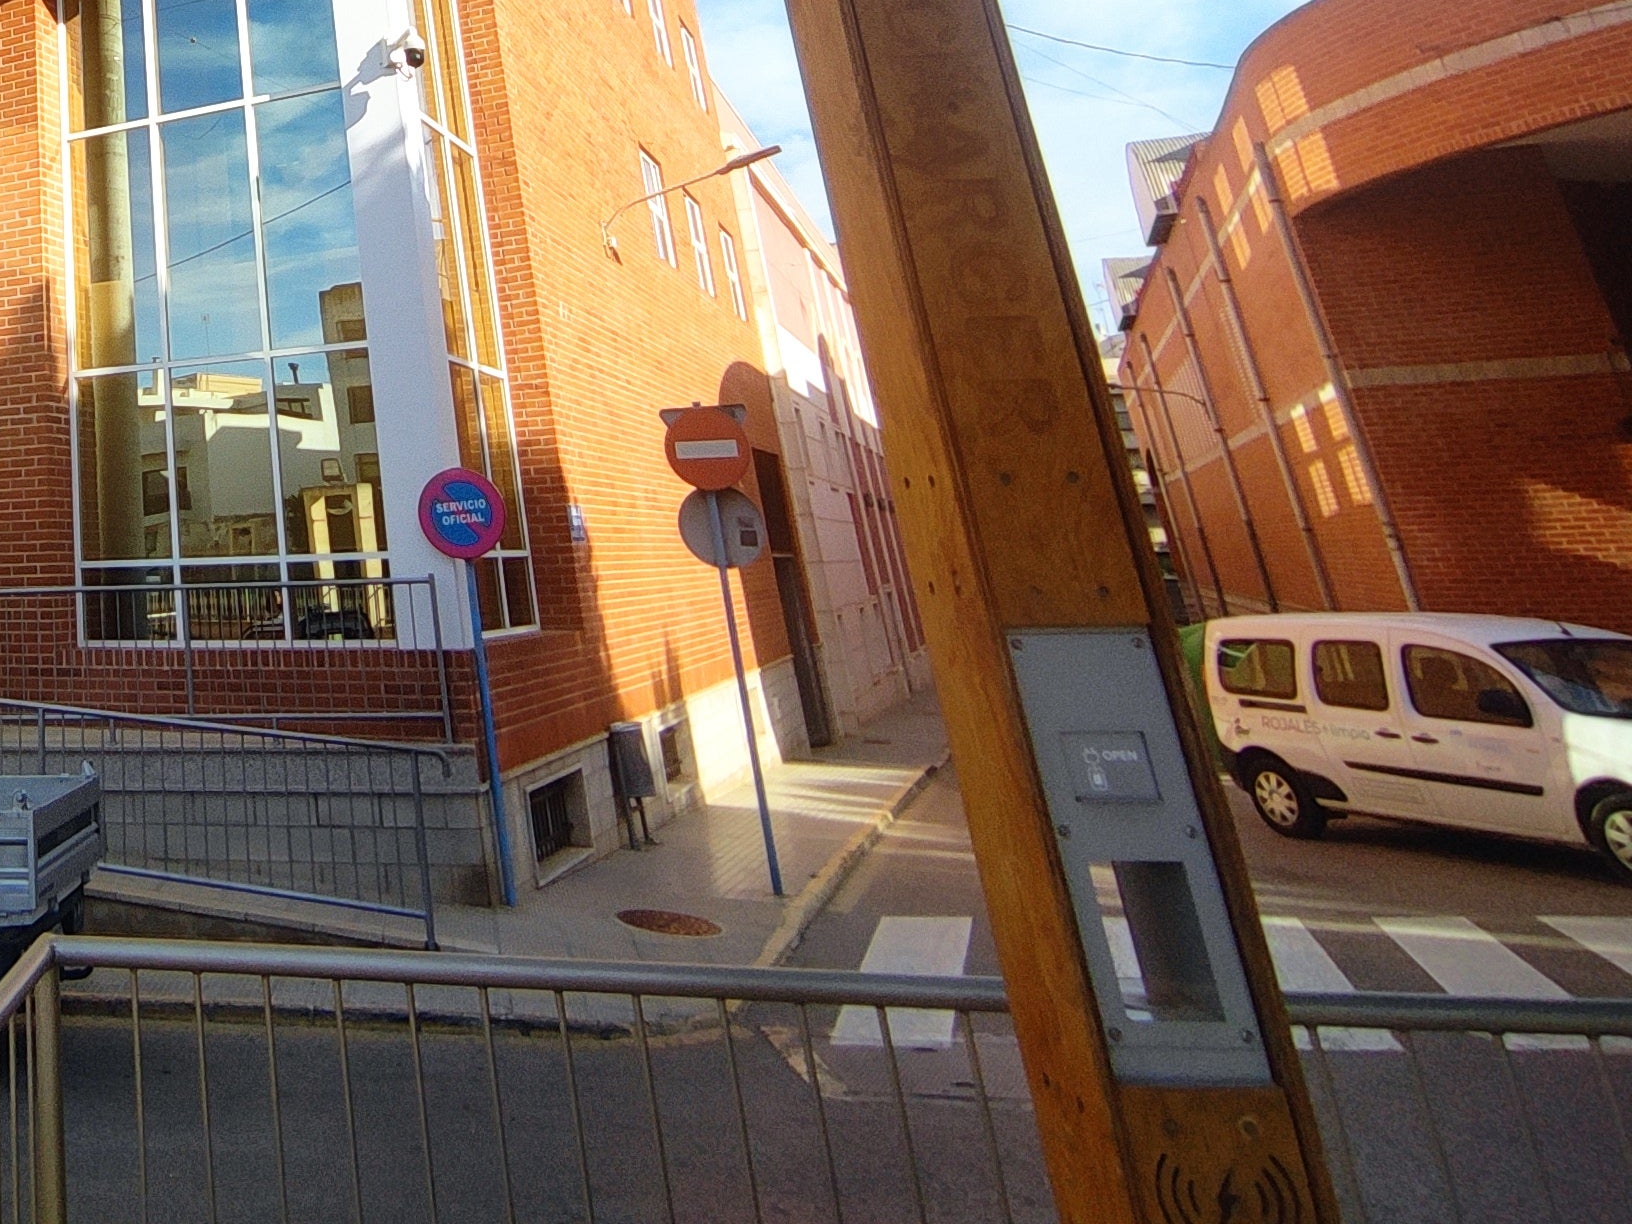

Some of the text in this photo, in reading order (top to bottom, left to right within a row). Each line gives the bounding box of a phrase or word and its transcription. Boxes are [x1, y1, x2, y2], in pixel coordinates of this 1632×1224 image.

[435, 498, 486, 514] SERVICIO
[441, 512, 485, 526] OFICIAL
[1261, 716, 1321, 735] ROJALES
[1101, 750, 1138, 761] OPEN
